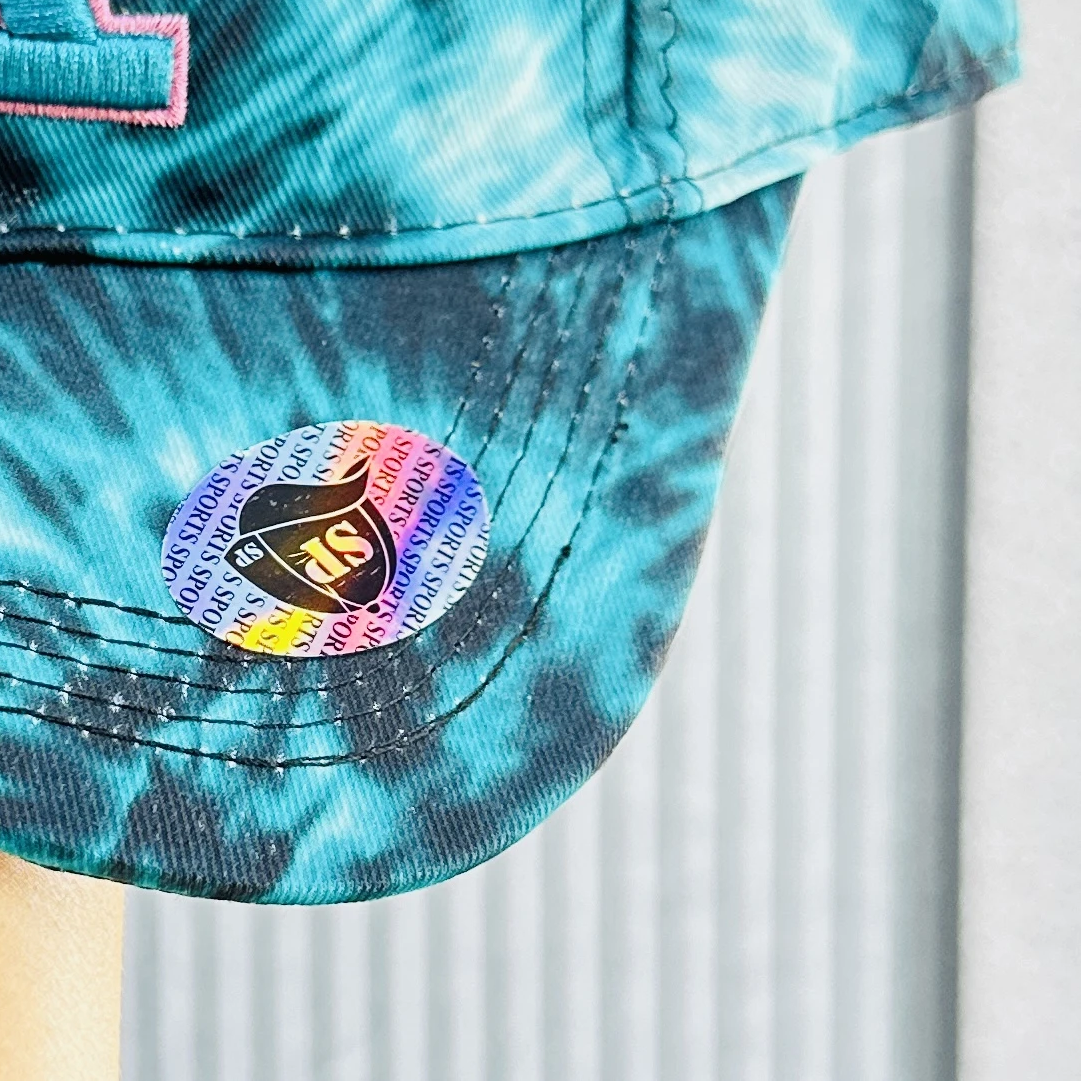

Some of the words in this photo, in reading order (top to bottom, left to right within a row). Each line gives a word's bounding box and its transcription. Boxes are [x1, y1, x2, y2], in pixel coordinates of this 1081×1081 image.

[178, 472, 231, 545] SPORTS
[389, 461, 434, 528] SPORTS
[409, 478, 457, 546] SPORTS
[234, 541, 265, 568] SP
[432, 499, 477, 569] SPORTS
